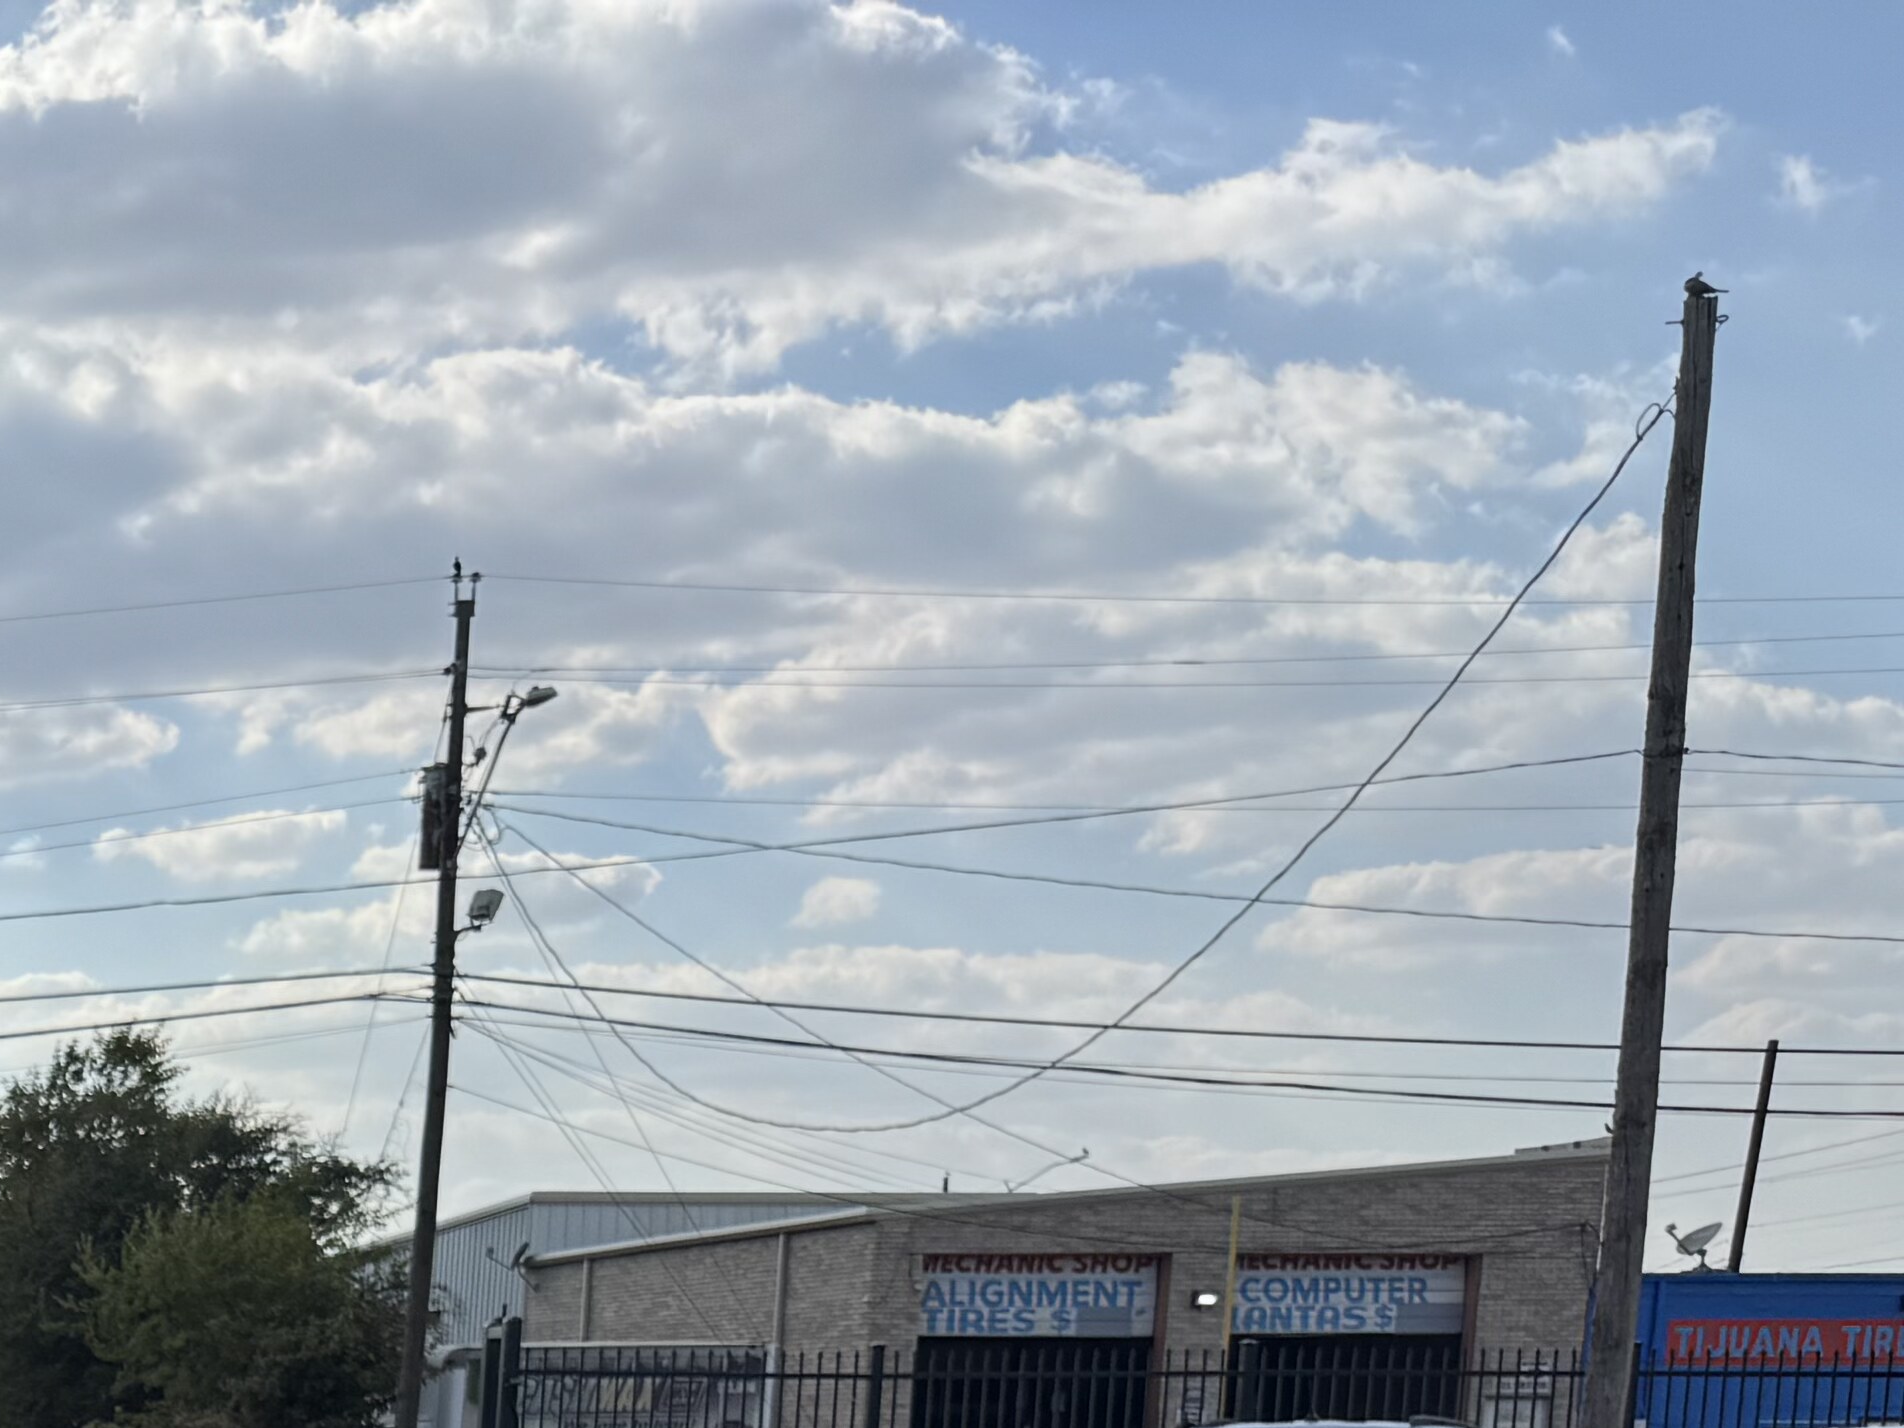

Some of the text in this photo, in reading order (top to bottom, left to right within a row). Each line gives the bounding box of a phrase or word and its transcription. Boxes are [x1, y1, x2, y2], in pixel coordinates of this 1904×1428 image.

[922, 1253, 1154, 1274] MECHANIC SHOP
[922, 1279, 1142, 1309] ALIGNMENT
[1239, 1276, 1428, 1305] COMPUTER
[922, 1307, 1036, 1334] TIRES
[1674, 1325, 1824, 1359] TIJUANA
